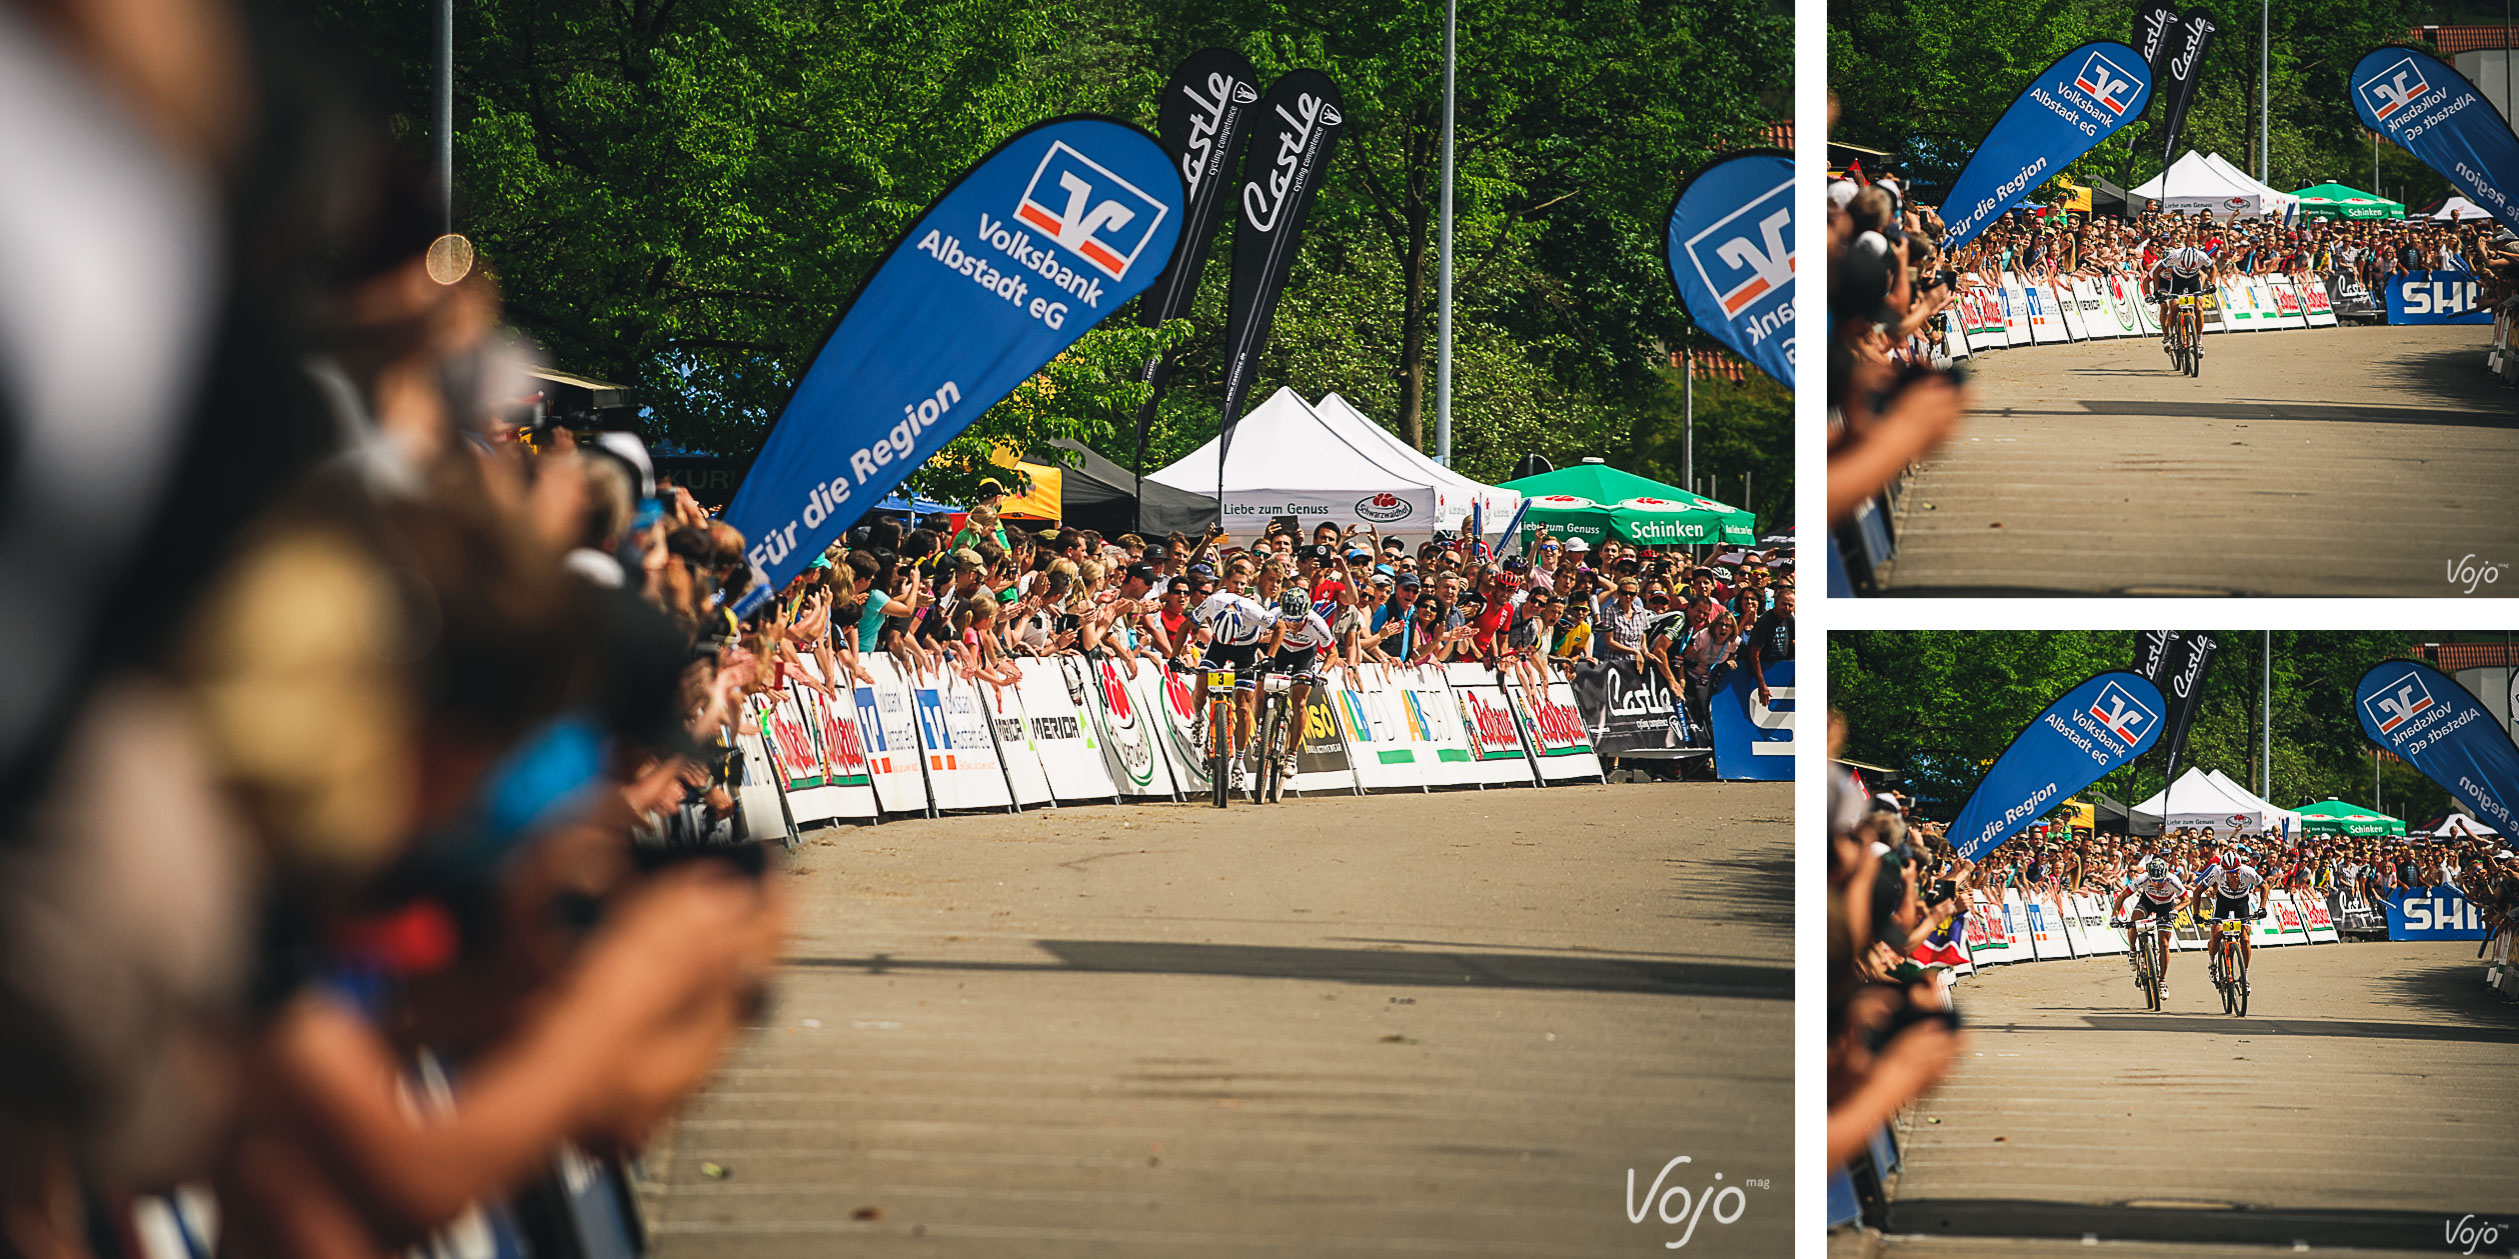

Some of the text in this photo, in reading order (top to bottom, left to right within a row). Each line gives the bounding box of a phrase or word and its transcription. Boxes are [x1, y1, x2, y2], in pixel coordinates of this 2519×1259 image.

[2144, 8, 2168, 64] astle
[2171, 17, 2206, 81] Castle
[2029, 87, 2099, 138] Albstadt eG
[2057, 81, 2115, 129] Volksbank
[1182, 71, 1234, 203] astle
[1243, 92, 1322, 233] Castle
[1948, 156, 2048, 237] Für die Region
[2348, 207, 2383, 217] Schinken
[916, 228, 1070, 331] Albstadt eG
[977, 212, 1104, 309] Volksbank
[2184, 296, 2189, 304] 3
[748, 380, 962, 584] Für die Region
[1223, 502, 1330, 515] Liebe zum Genuss
[1357, 502, 1411, 520] Schwarzwaldhof
[1545, 523, 1564, 532] zum
[1566, 522, 1600, 535] Genuss
[1630, 519, 1704, 539] Schinken
[1217, 673, 1225, 686] 3
[1275, 680, 1280, 690] 1
[2173, 634, 2208, 698] Castle
[1607, 666, 1676, 717] Castle
[1030, 716, 1081, 740] MERIDA
[2044, 713, 2110, 767] Albstadt eG
[2071, 708, 2126, 758] Volksbank
[1956, 781, 2058, 860] Für die Region
[2349, 825, 2383, 834] Schinken
[2229, 921, 2235, 931] 3
